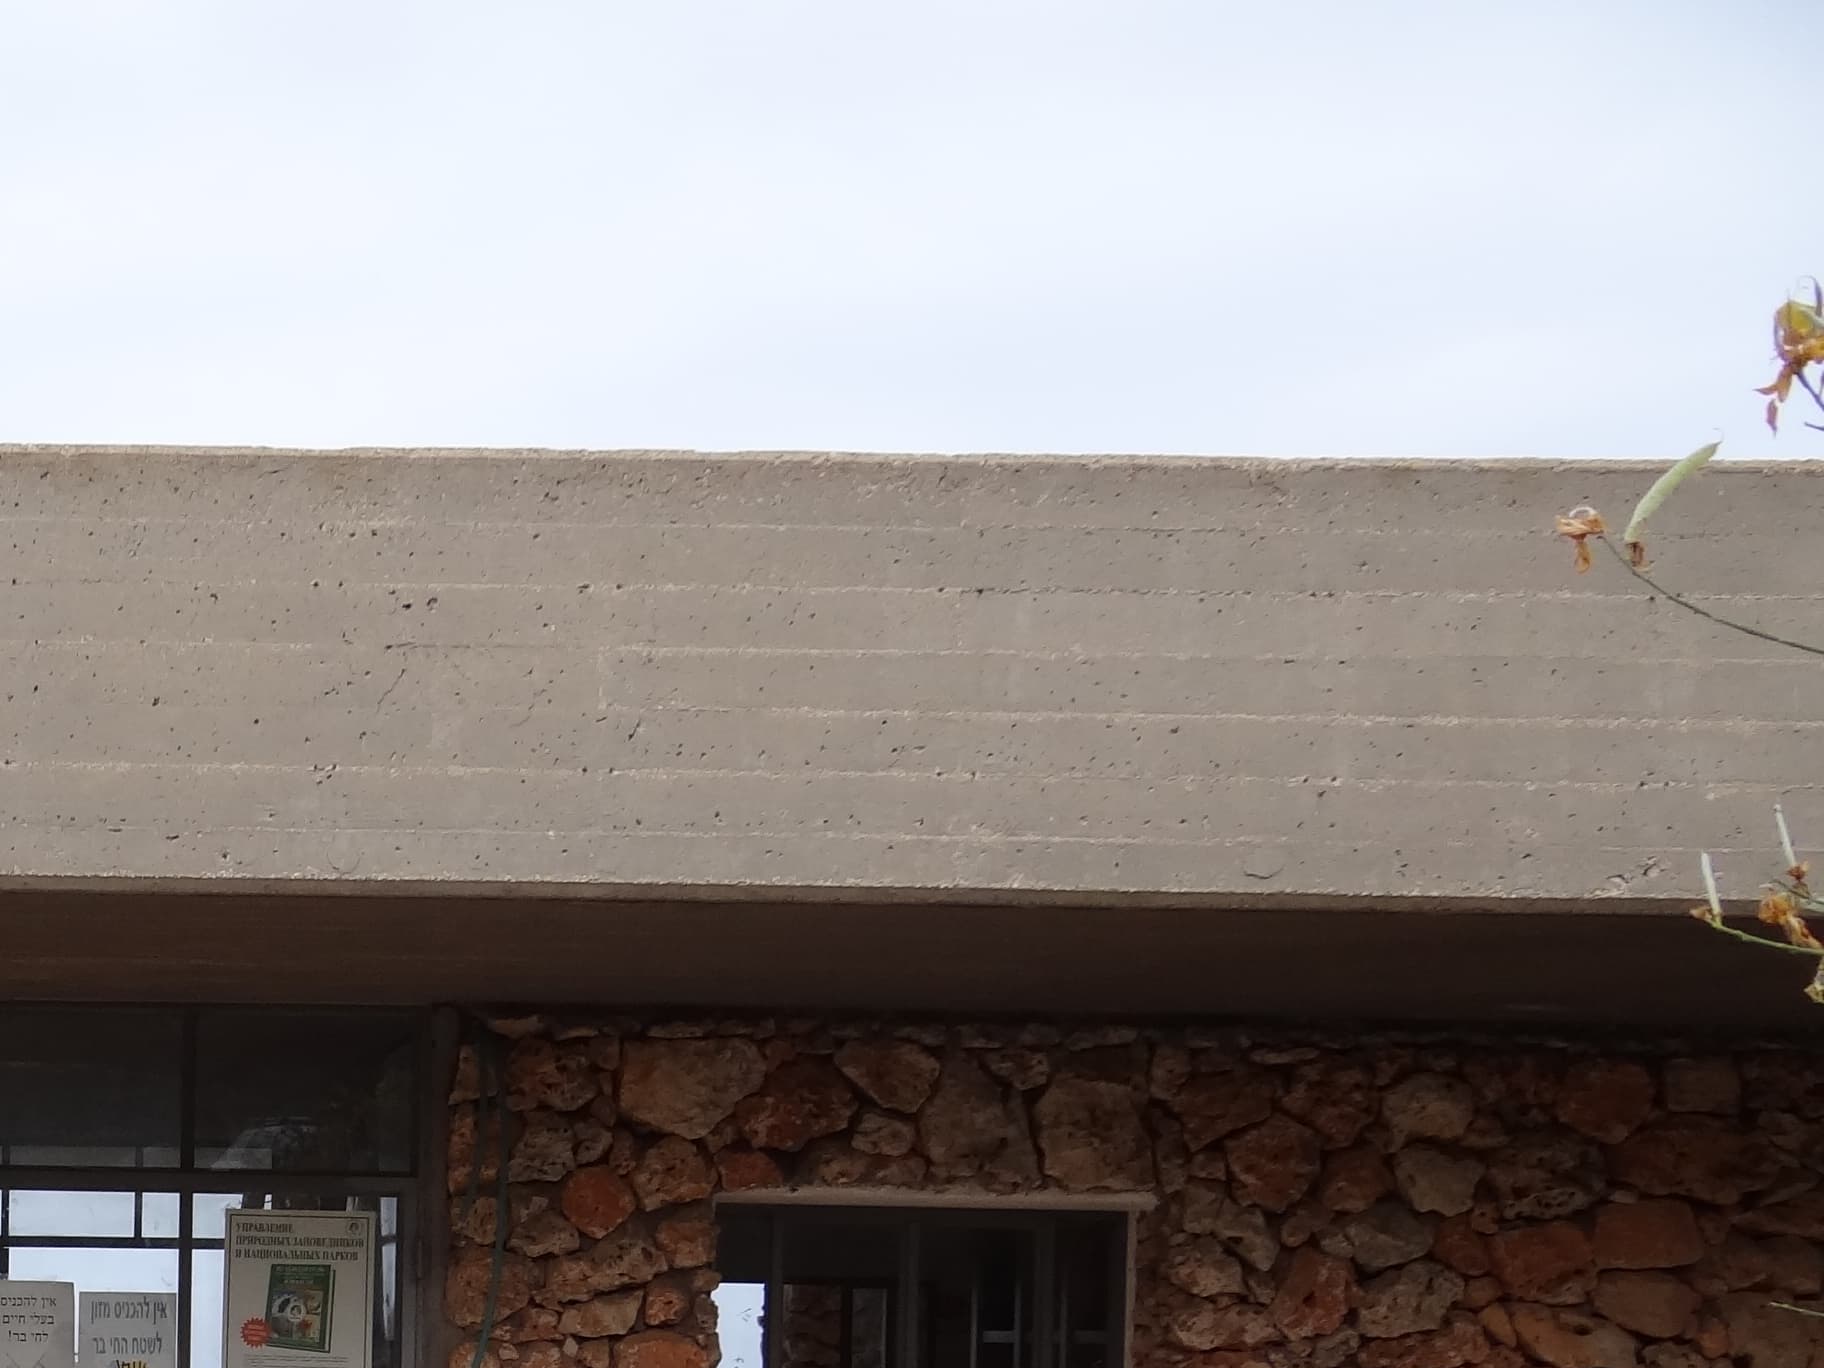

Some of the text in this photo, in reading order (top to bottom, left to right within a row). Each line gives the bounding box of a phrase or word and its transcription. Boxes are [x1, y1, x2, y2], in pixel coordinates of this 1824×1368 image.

[235, 1222, 294, 1234] УПРАВЛЕНИЕ
[235, 1236, 365, 1249] ПРИРОДНЫХ ЗАПОВЕДНИКОВ
[243, 1249, 321, 1261] НАЦИОНАЛЬНЫХ
[322, 1250, 359, 1262] ПАРКОВ
[0, 1294, 57, 1309] אין להכניס
[90, 1295, 168, 1325] אין להכניס מזון
[1, 1312, 55, 1325] בעלי חיים
[8, 1329, 49, 1343] לחי בר!
[92, 1331, 163, 1354] לשטח החי בר
